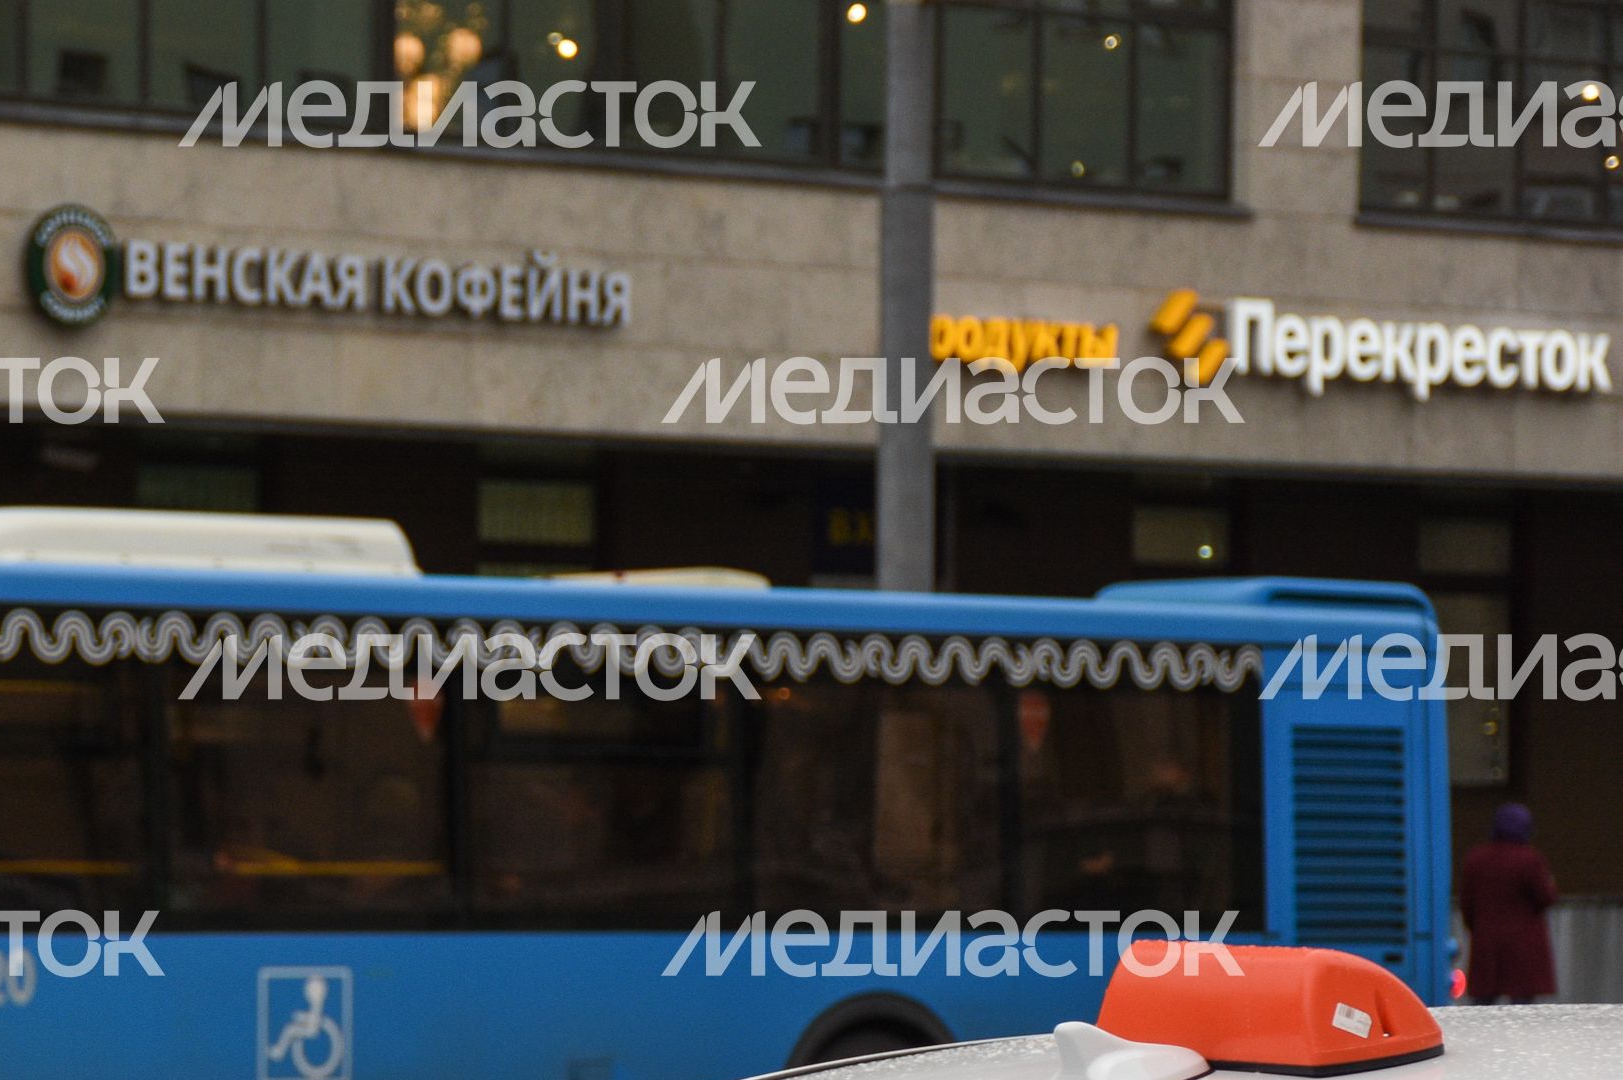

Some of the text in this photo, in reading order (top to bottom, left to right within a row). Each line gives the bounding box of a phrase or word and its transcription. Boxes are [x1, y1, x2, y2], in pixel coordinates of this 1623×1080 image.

[124, 240, 367, 311] ВЕНСКАЯ
[382, 250, 632, 326] КОФЕЙНЯ
[929, 314, 1120, 372] родукты
[1233, 297, 1614, 400] Перекресток
